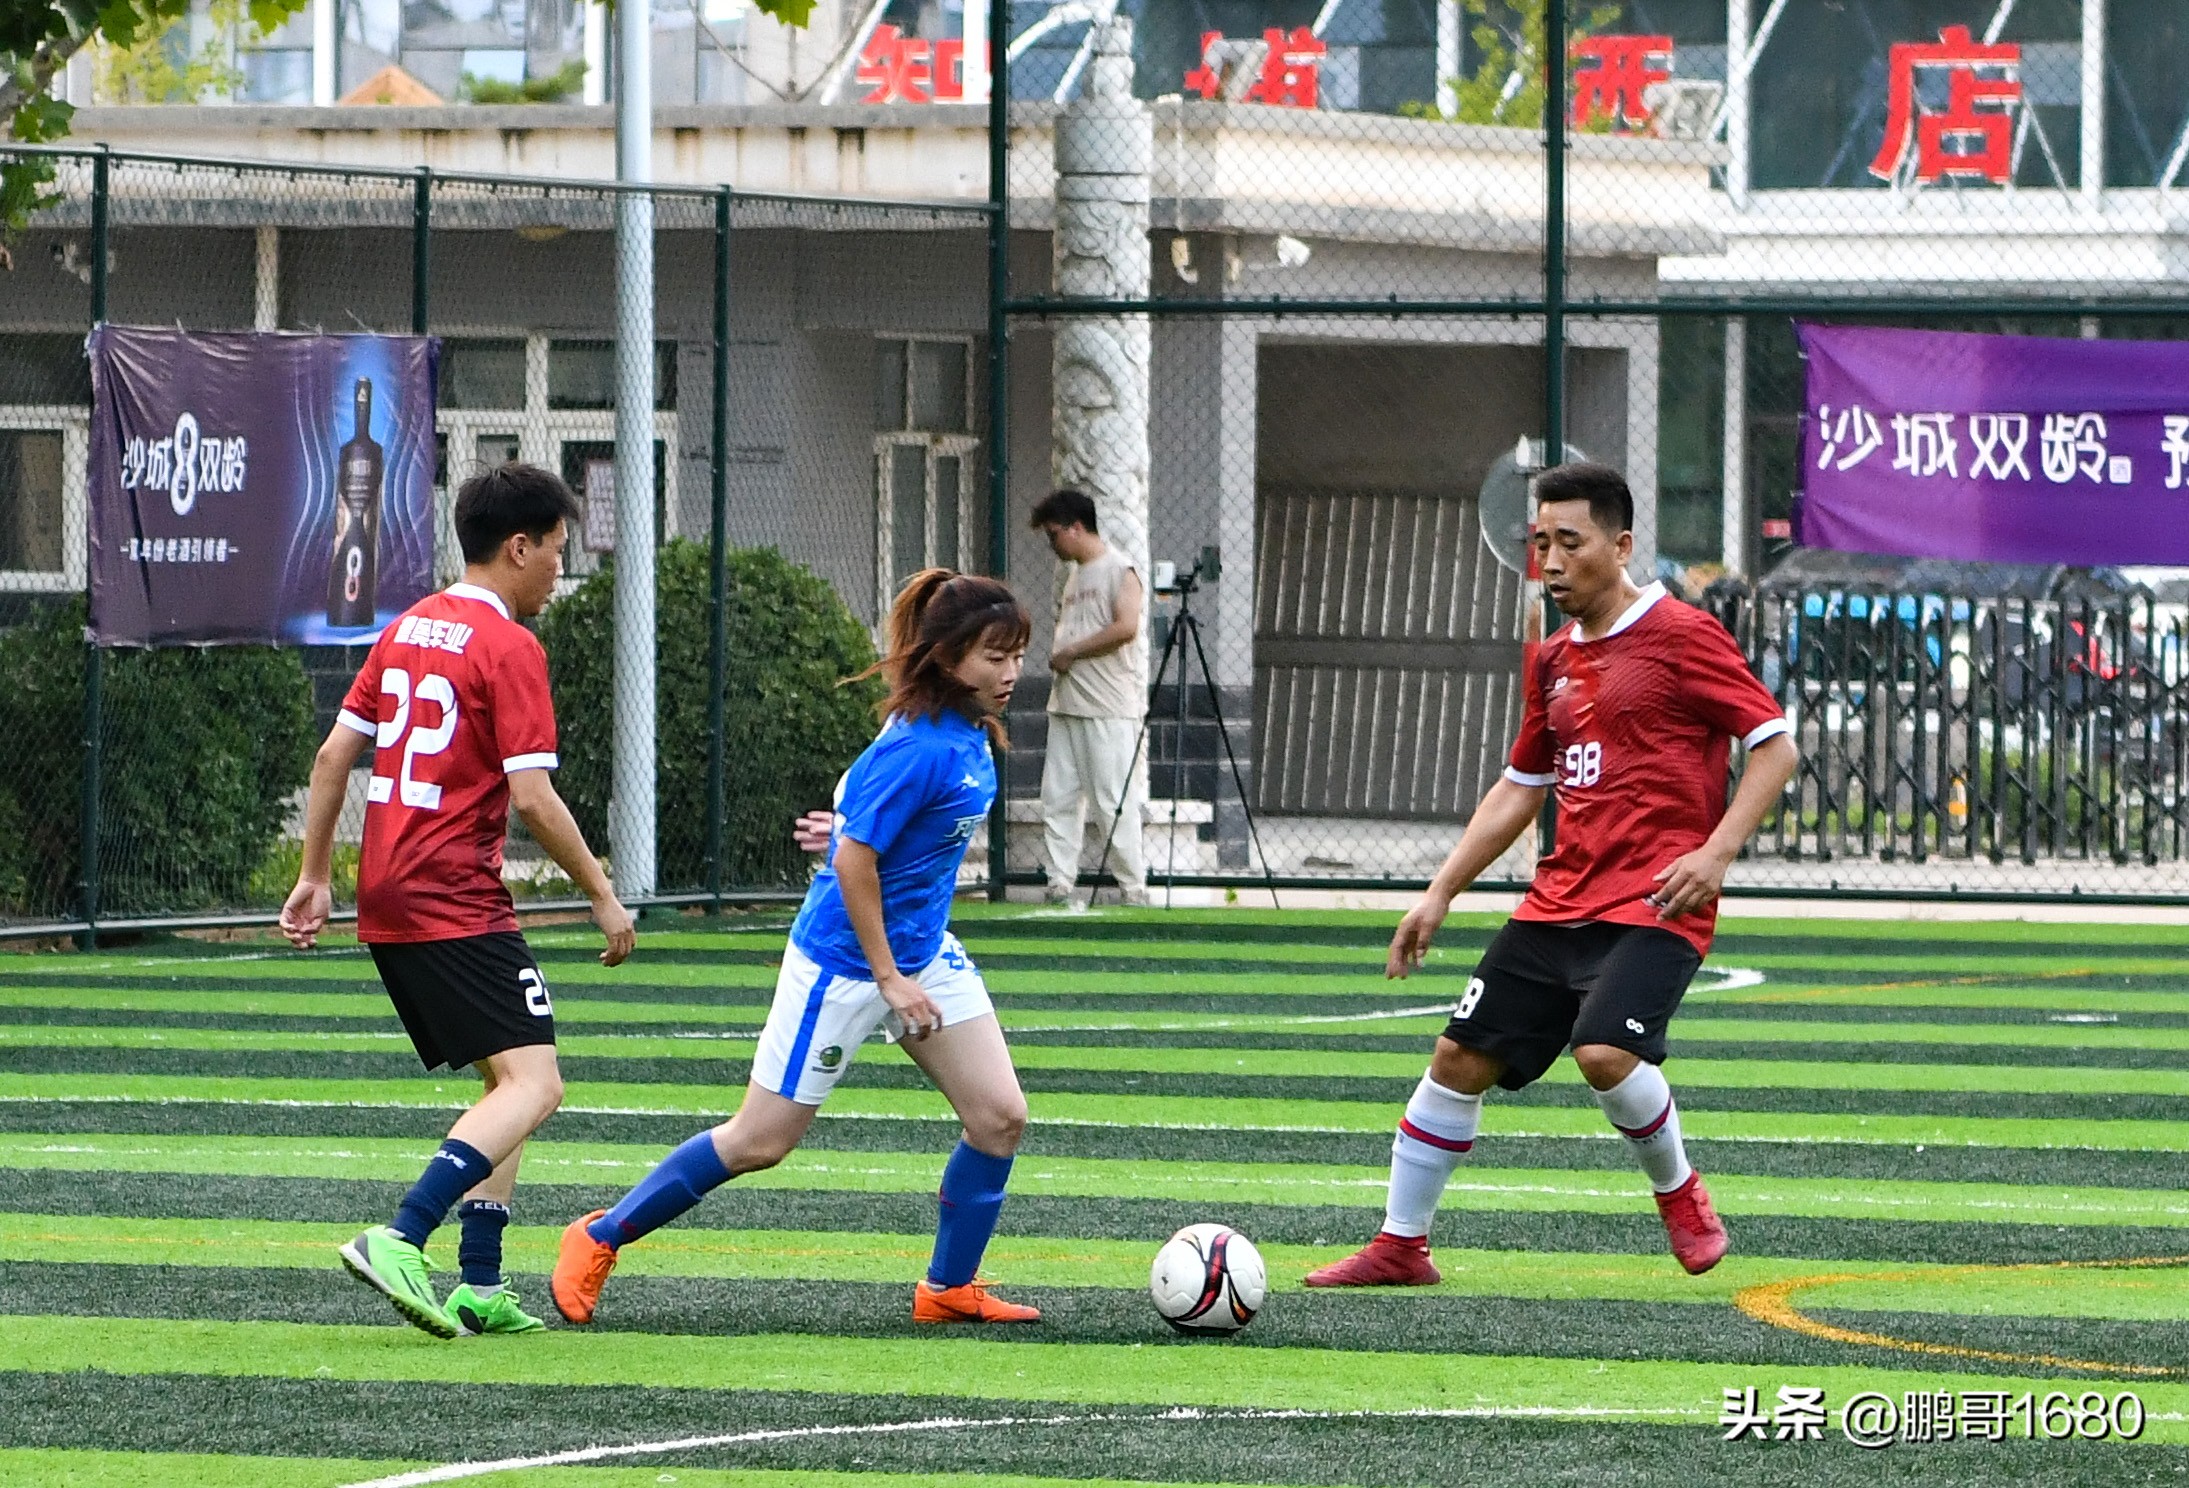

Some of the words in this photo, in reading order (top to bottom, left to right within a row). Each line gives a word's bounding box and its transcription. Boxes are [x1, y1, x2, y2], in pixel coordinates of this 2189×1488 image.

[1817, 403, 2107, 485] 沙城双龄
[367, 667, 460, 811] 22
[1563, 741, 1602, 788] 98
